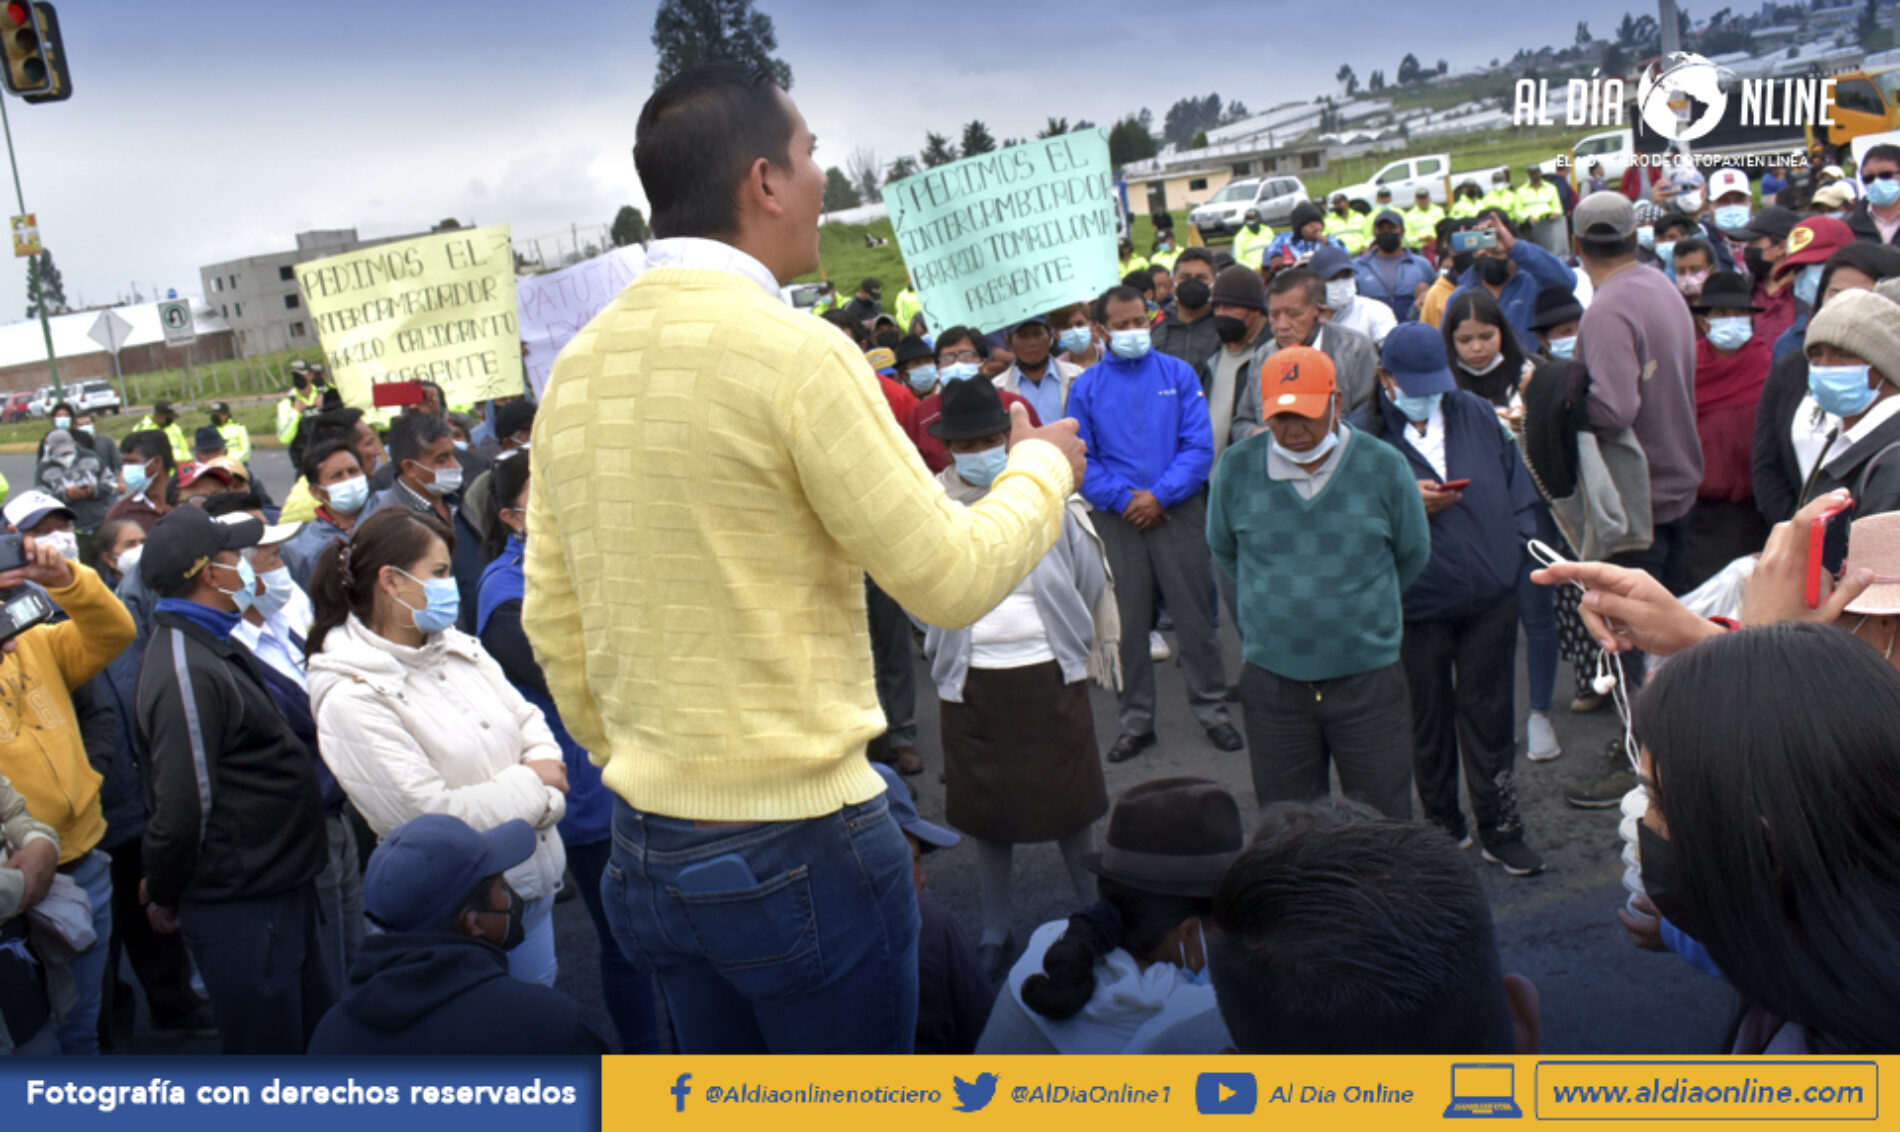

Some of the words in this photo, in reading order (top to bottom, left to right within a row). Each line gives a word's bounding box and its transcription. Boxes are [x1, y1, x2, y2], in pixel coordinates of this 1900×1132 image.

[909, 150, 1034, 213] PEDIMOS
[1045, 140, 1089, 173] EL
[302, 247, 424, 300] PEDIMOS
[446, 239, 488, 270] EL
[912, 243, 985, 292] BARRIO
[964, 256, 1074, 313] PRESENTE
